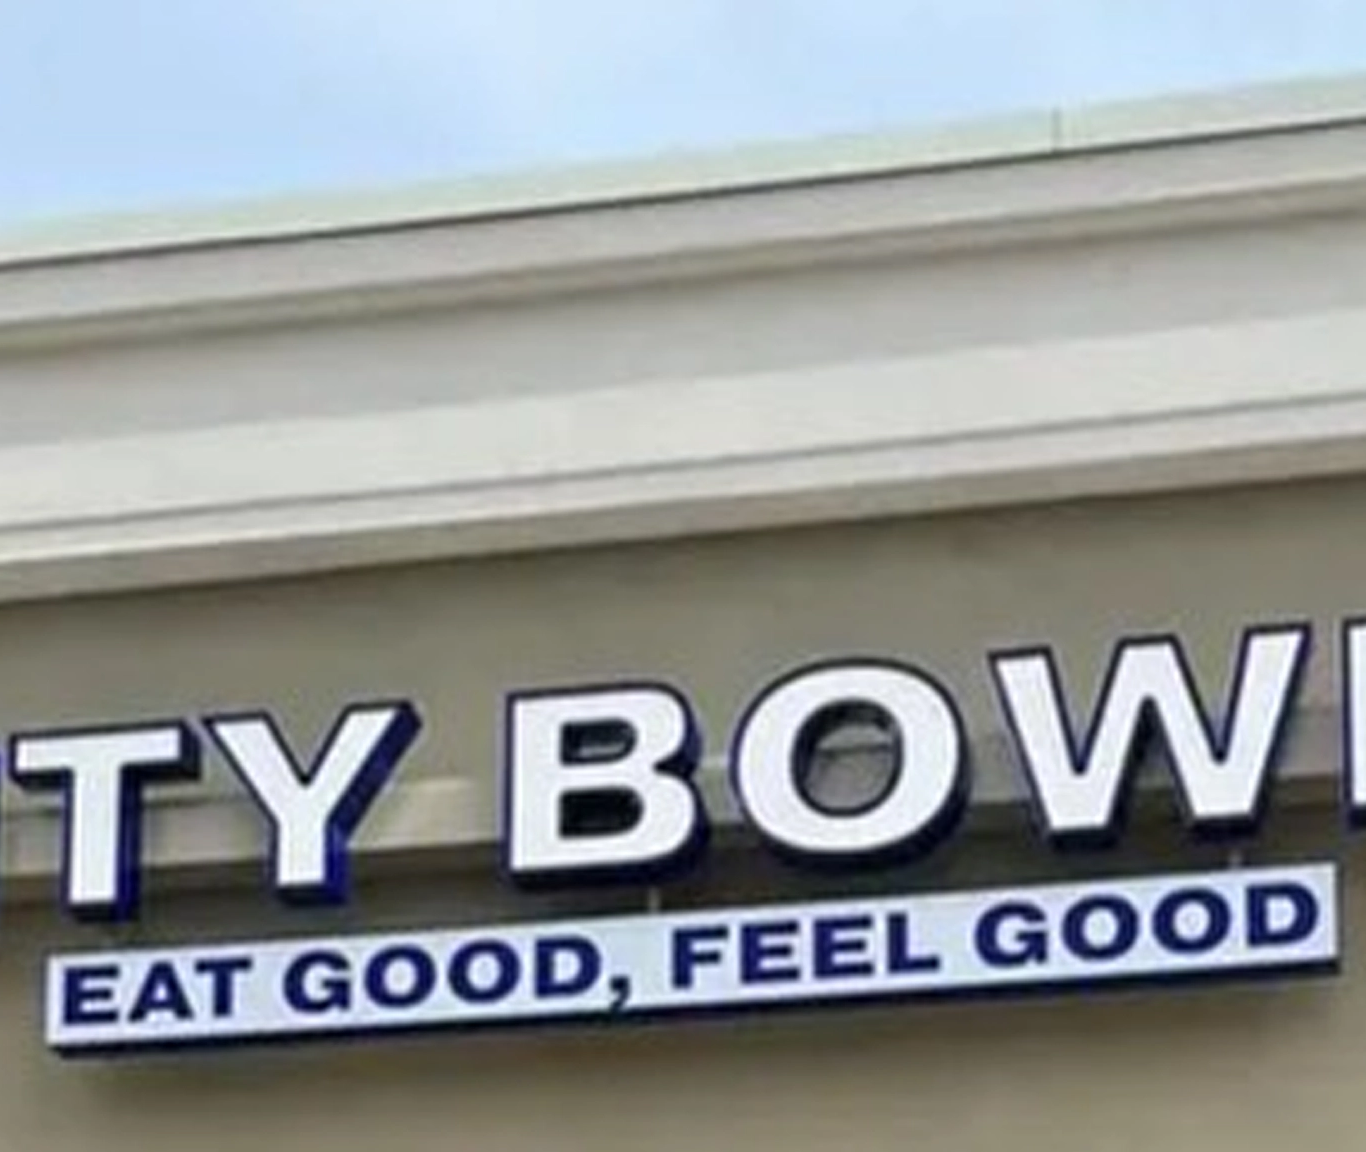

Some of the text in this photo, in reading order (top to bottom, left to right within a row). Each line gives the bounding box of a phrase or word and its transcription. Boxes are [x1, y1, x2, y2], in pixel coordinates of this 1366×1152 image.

[60, 881, 1320, 1026] EAT GOOD, FEEL GOOD
